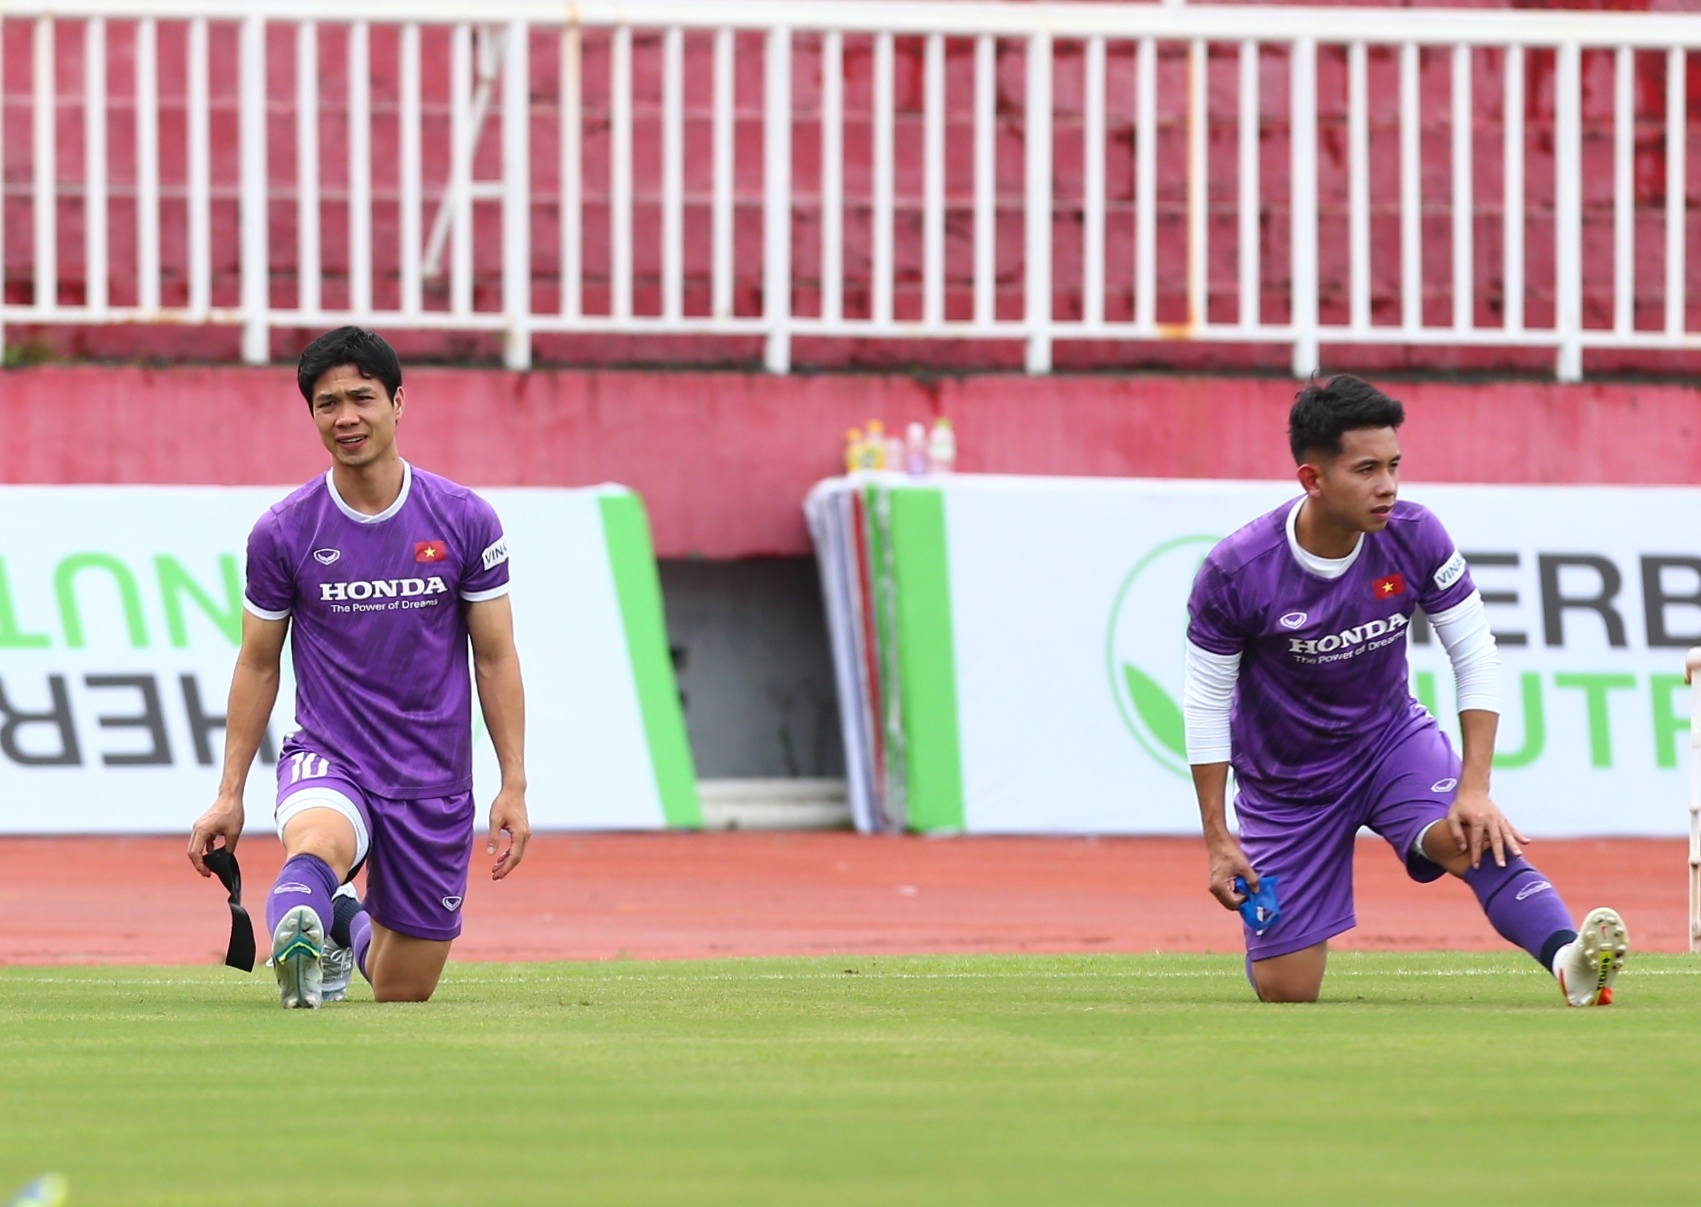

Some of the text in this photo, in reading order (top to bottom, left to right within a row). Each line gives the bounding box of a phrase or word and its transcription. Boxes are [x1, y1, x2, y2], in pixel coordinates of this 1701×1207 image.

[319, 576, 448, 601] HONDA
[330, 598, 439, 613] The Power of Dreams
[1410, 551, 1701, 648] ERB
[1288, 612, 1409, 655] HONDA
[1294, 630, 1406, 665] The Power of Dreams
[290, 751, 330, 785] 10
